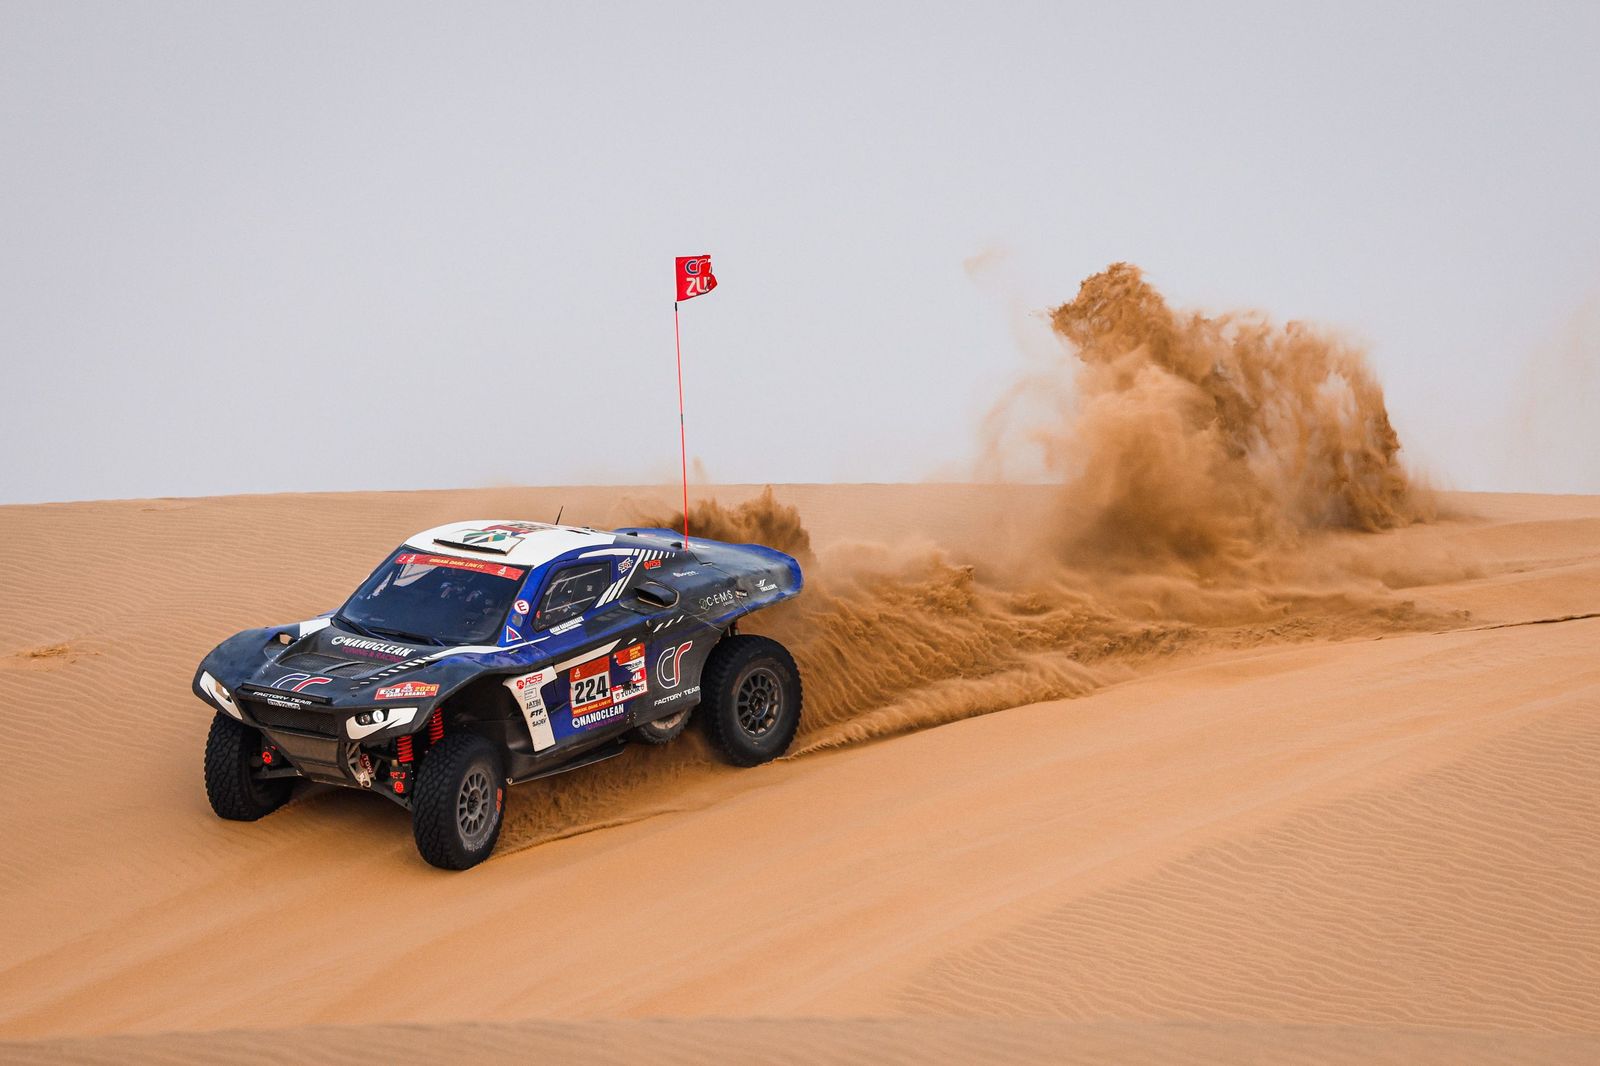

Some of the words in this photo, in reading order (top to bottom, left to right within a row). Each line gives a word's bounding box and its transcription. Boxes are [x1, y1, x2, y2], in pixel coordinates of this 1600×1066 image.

[342, 637, 413, 657] NANOCLEAN
[252, 691, 290, 701] FACTORY
[290, 697, 313, 706] TEAM
[574, 676, 609, 704] 224
[621, 687, 641, 698] TUDOR
[653, 692, 683, 707] FACTORY
[683, 685, 701, 696] TEAM
[530, 708, 544, 718] FTF
[579, 703, 625, 727] NANOCLEAN
